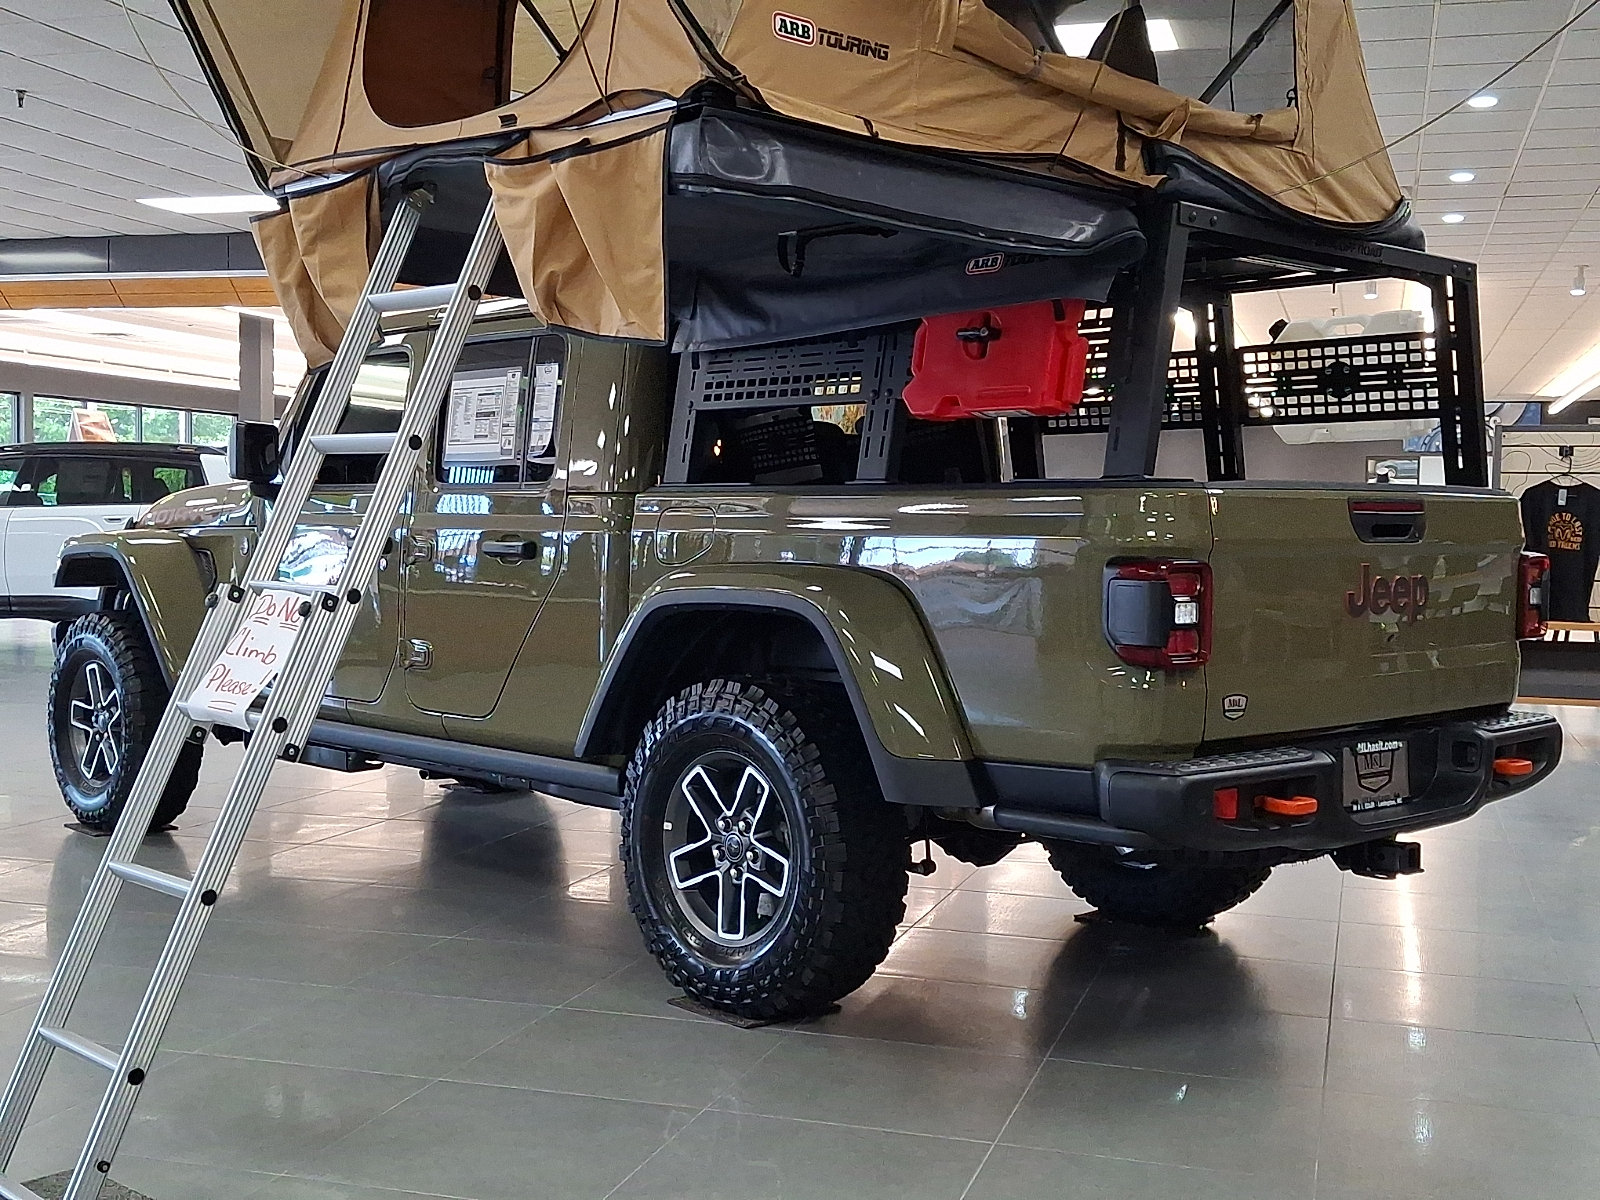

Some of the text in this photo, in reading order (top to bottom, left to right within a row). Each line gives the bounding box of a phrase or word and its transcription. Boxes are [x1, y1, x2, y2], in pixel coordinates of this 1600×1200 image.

[778, 18, 890, 61] ARB TOURING
[970, 256, 1000, 270] ARB
[249, 594, 301, 624] Do No
[1344, 563, 1429, 624] Jeep
[225, 626, 277, 665] Climb
